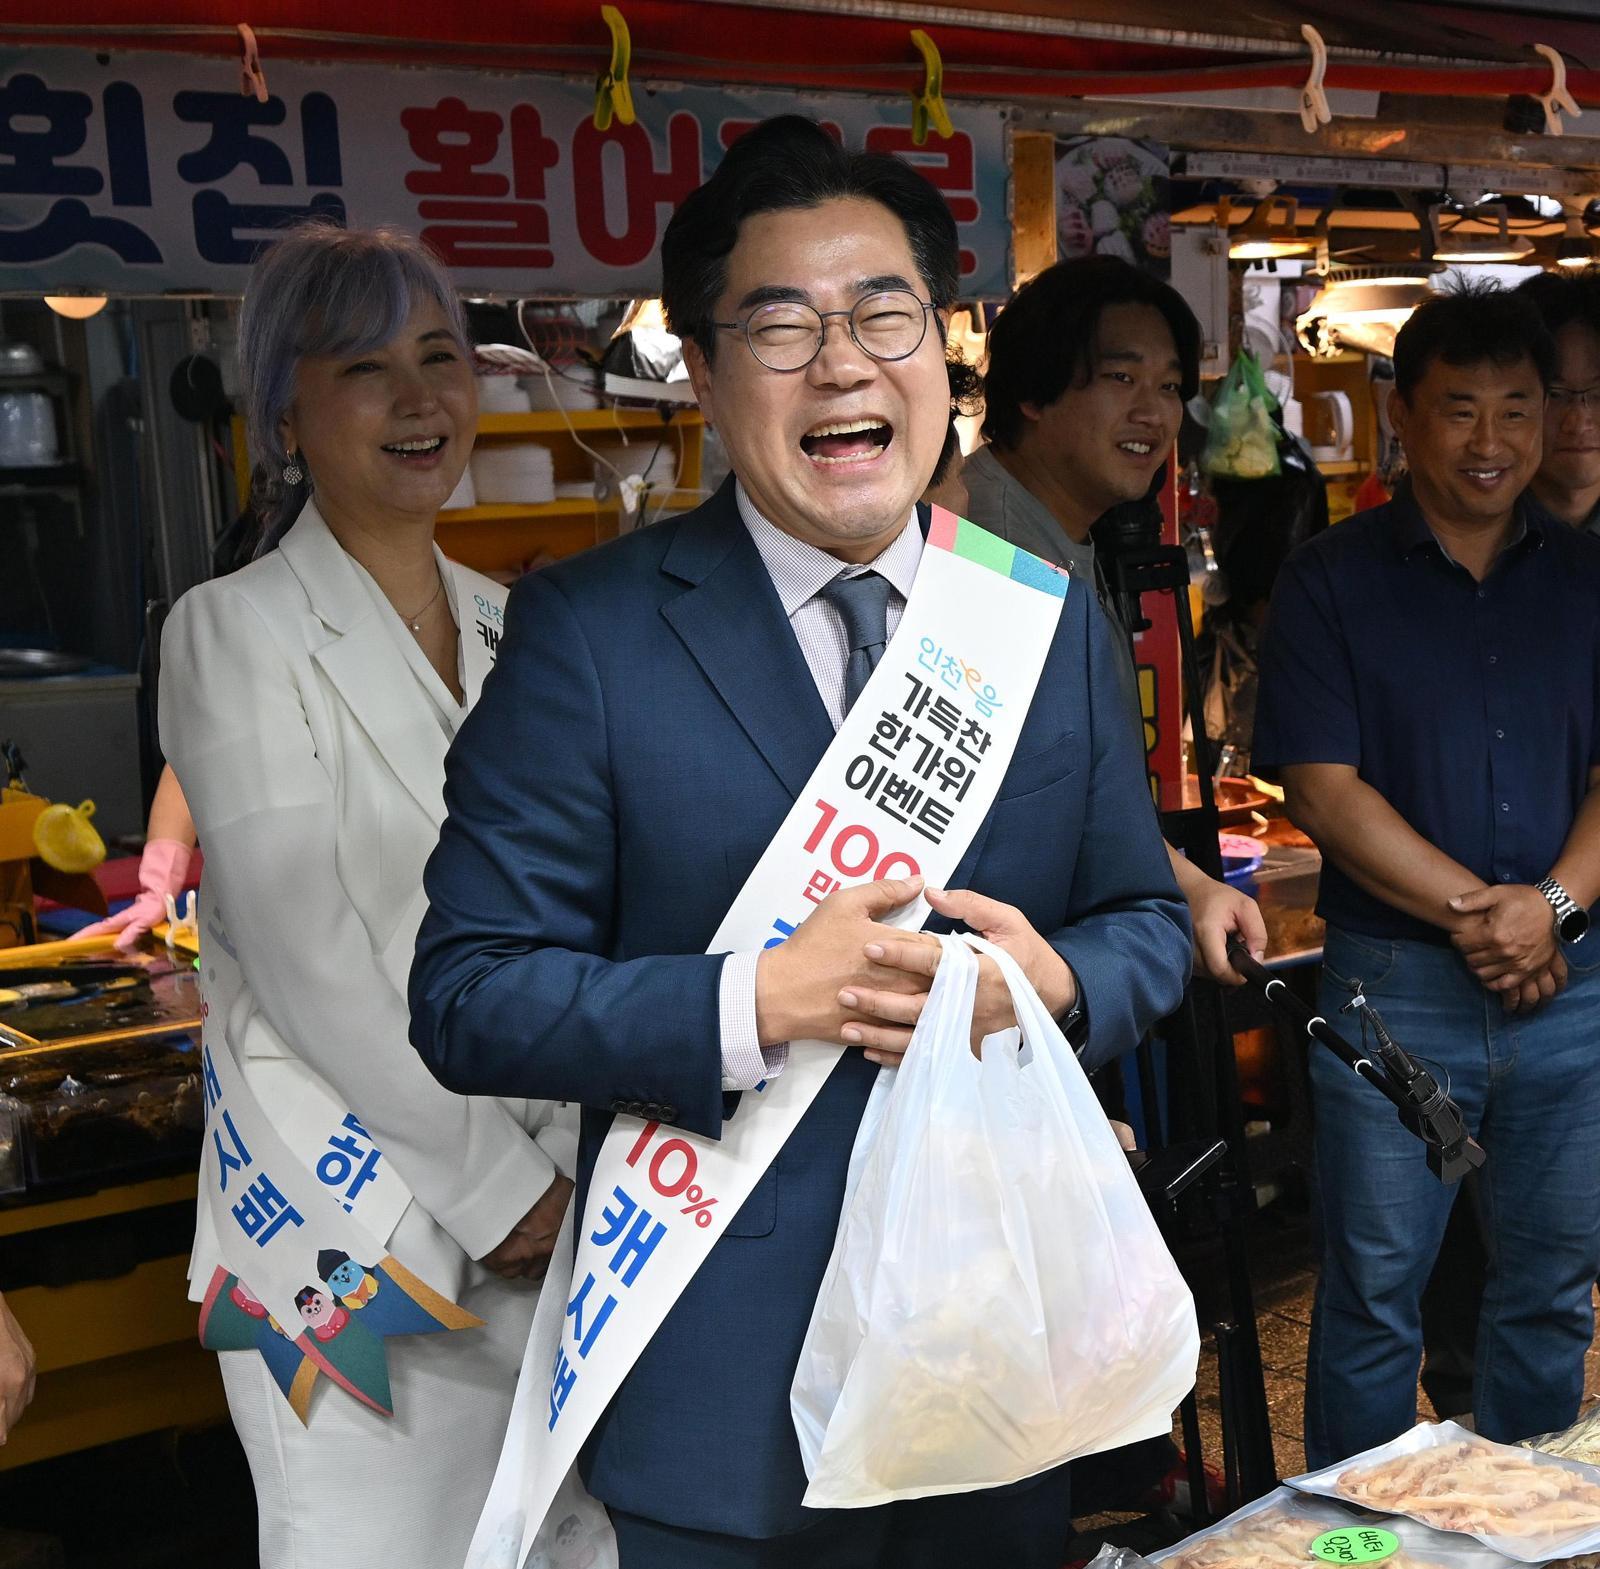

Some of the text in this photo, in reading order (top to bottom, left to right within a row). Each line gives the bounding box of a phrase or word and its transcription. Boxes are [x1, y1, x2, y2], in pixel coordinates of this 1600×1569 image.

[868, 710, 976, 803] 한가위
[902, 671, 993, 764] 가득찬
[802, 798, 921, 881] 100
[845, 754, 955, 846] 이벤트
[625, 1120, 719, 1229] 10%
